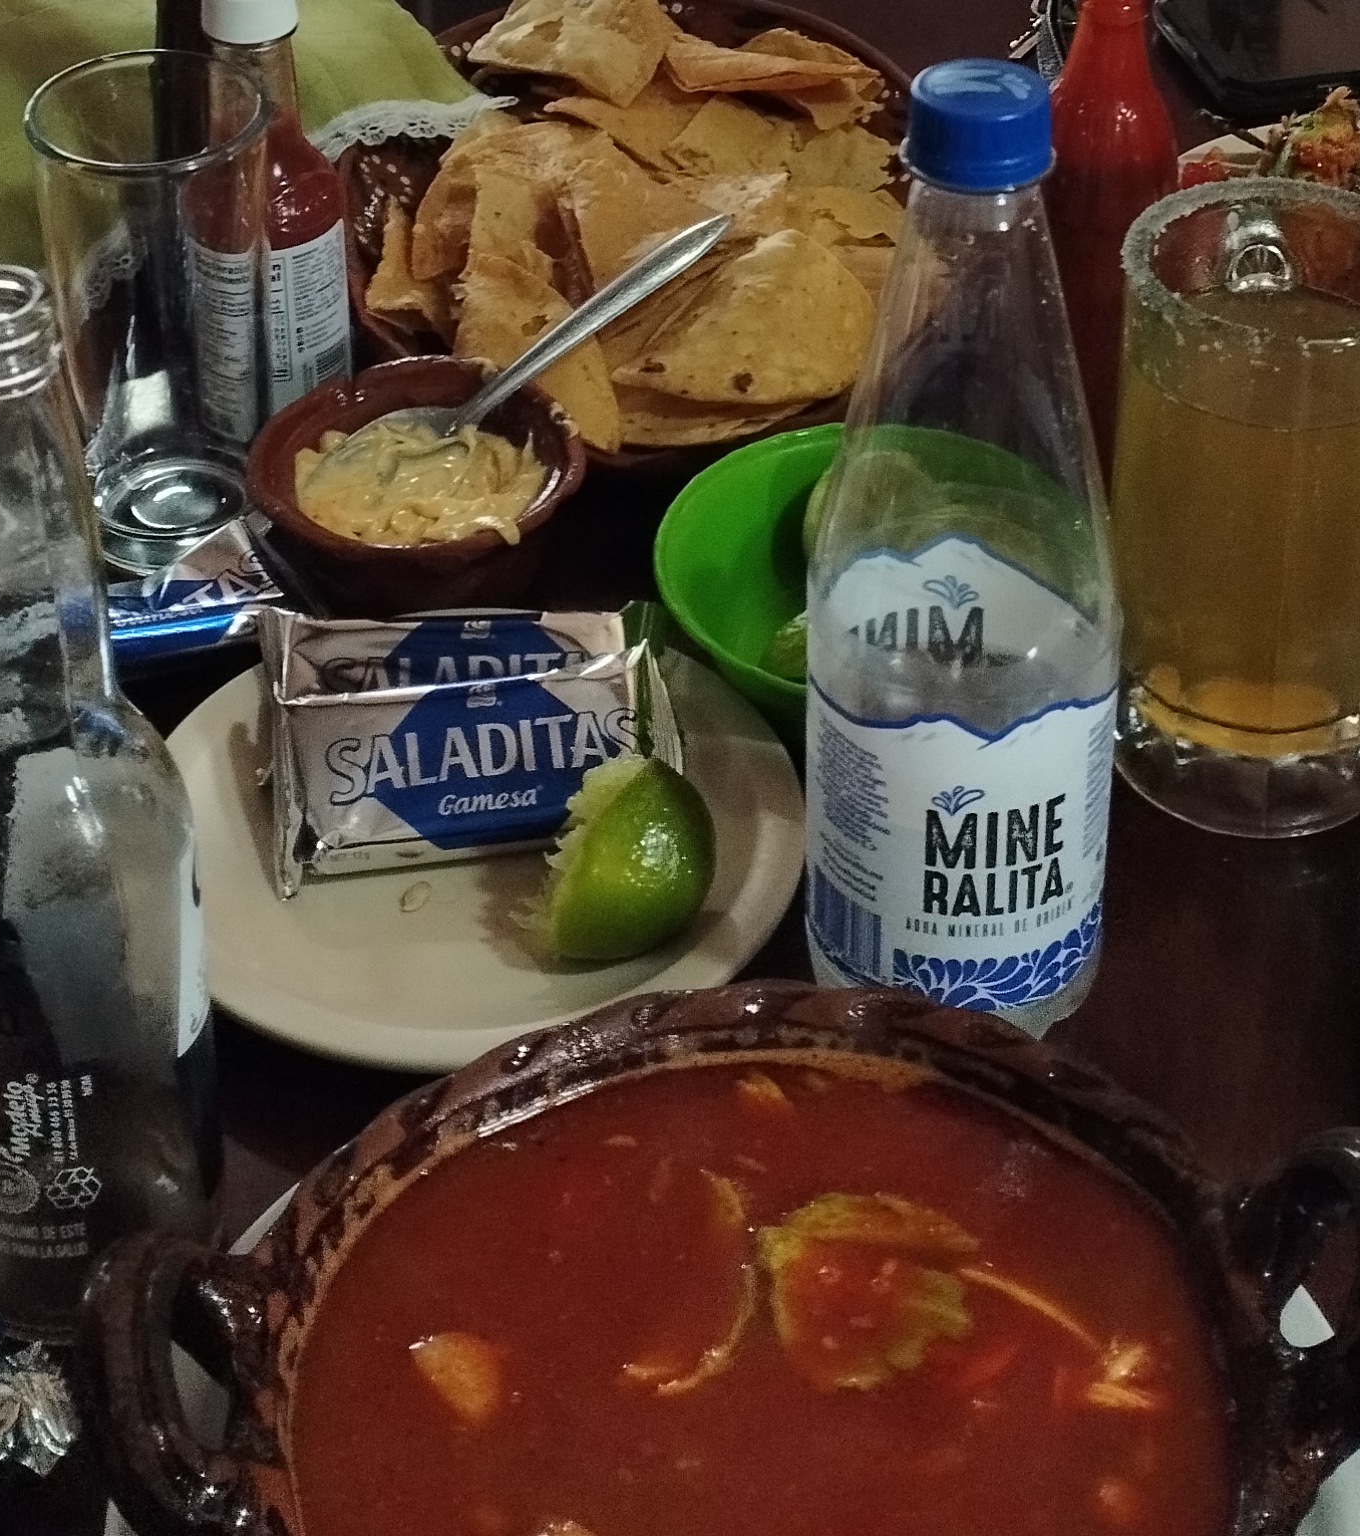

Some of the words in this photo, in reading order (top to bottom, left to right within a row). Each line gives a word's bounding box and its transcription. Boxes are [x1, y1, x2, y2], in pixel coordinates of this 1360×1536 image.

[324, 706, 638, 806] SALADITAS
[437, 786, 538, 816] Gamesa
[924, 792, 1066, 869] MINE
[922, 857, 1065, 917] RALITA
[948, 922, 1005, 937] MINERAL
[1014, 917, 1028, 934] DE
[2, 1080, 31, 1156] Modelo
